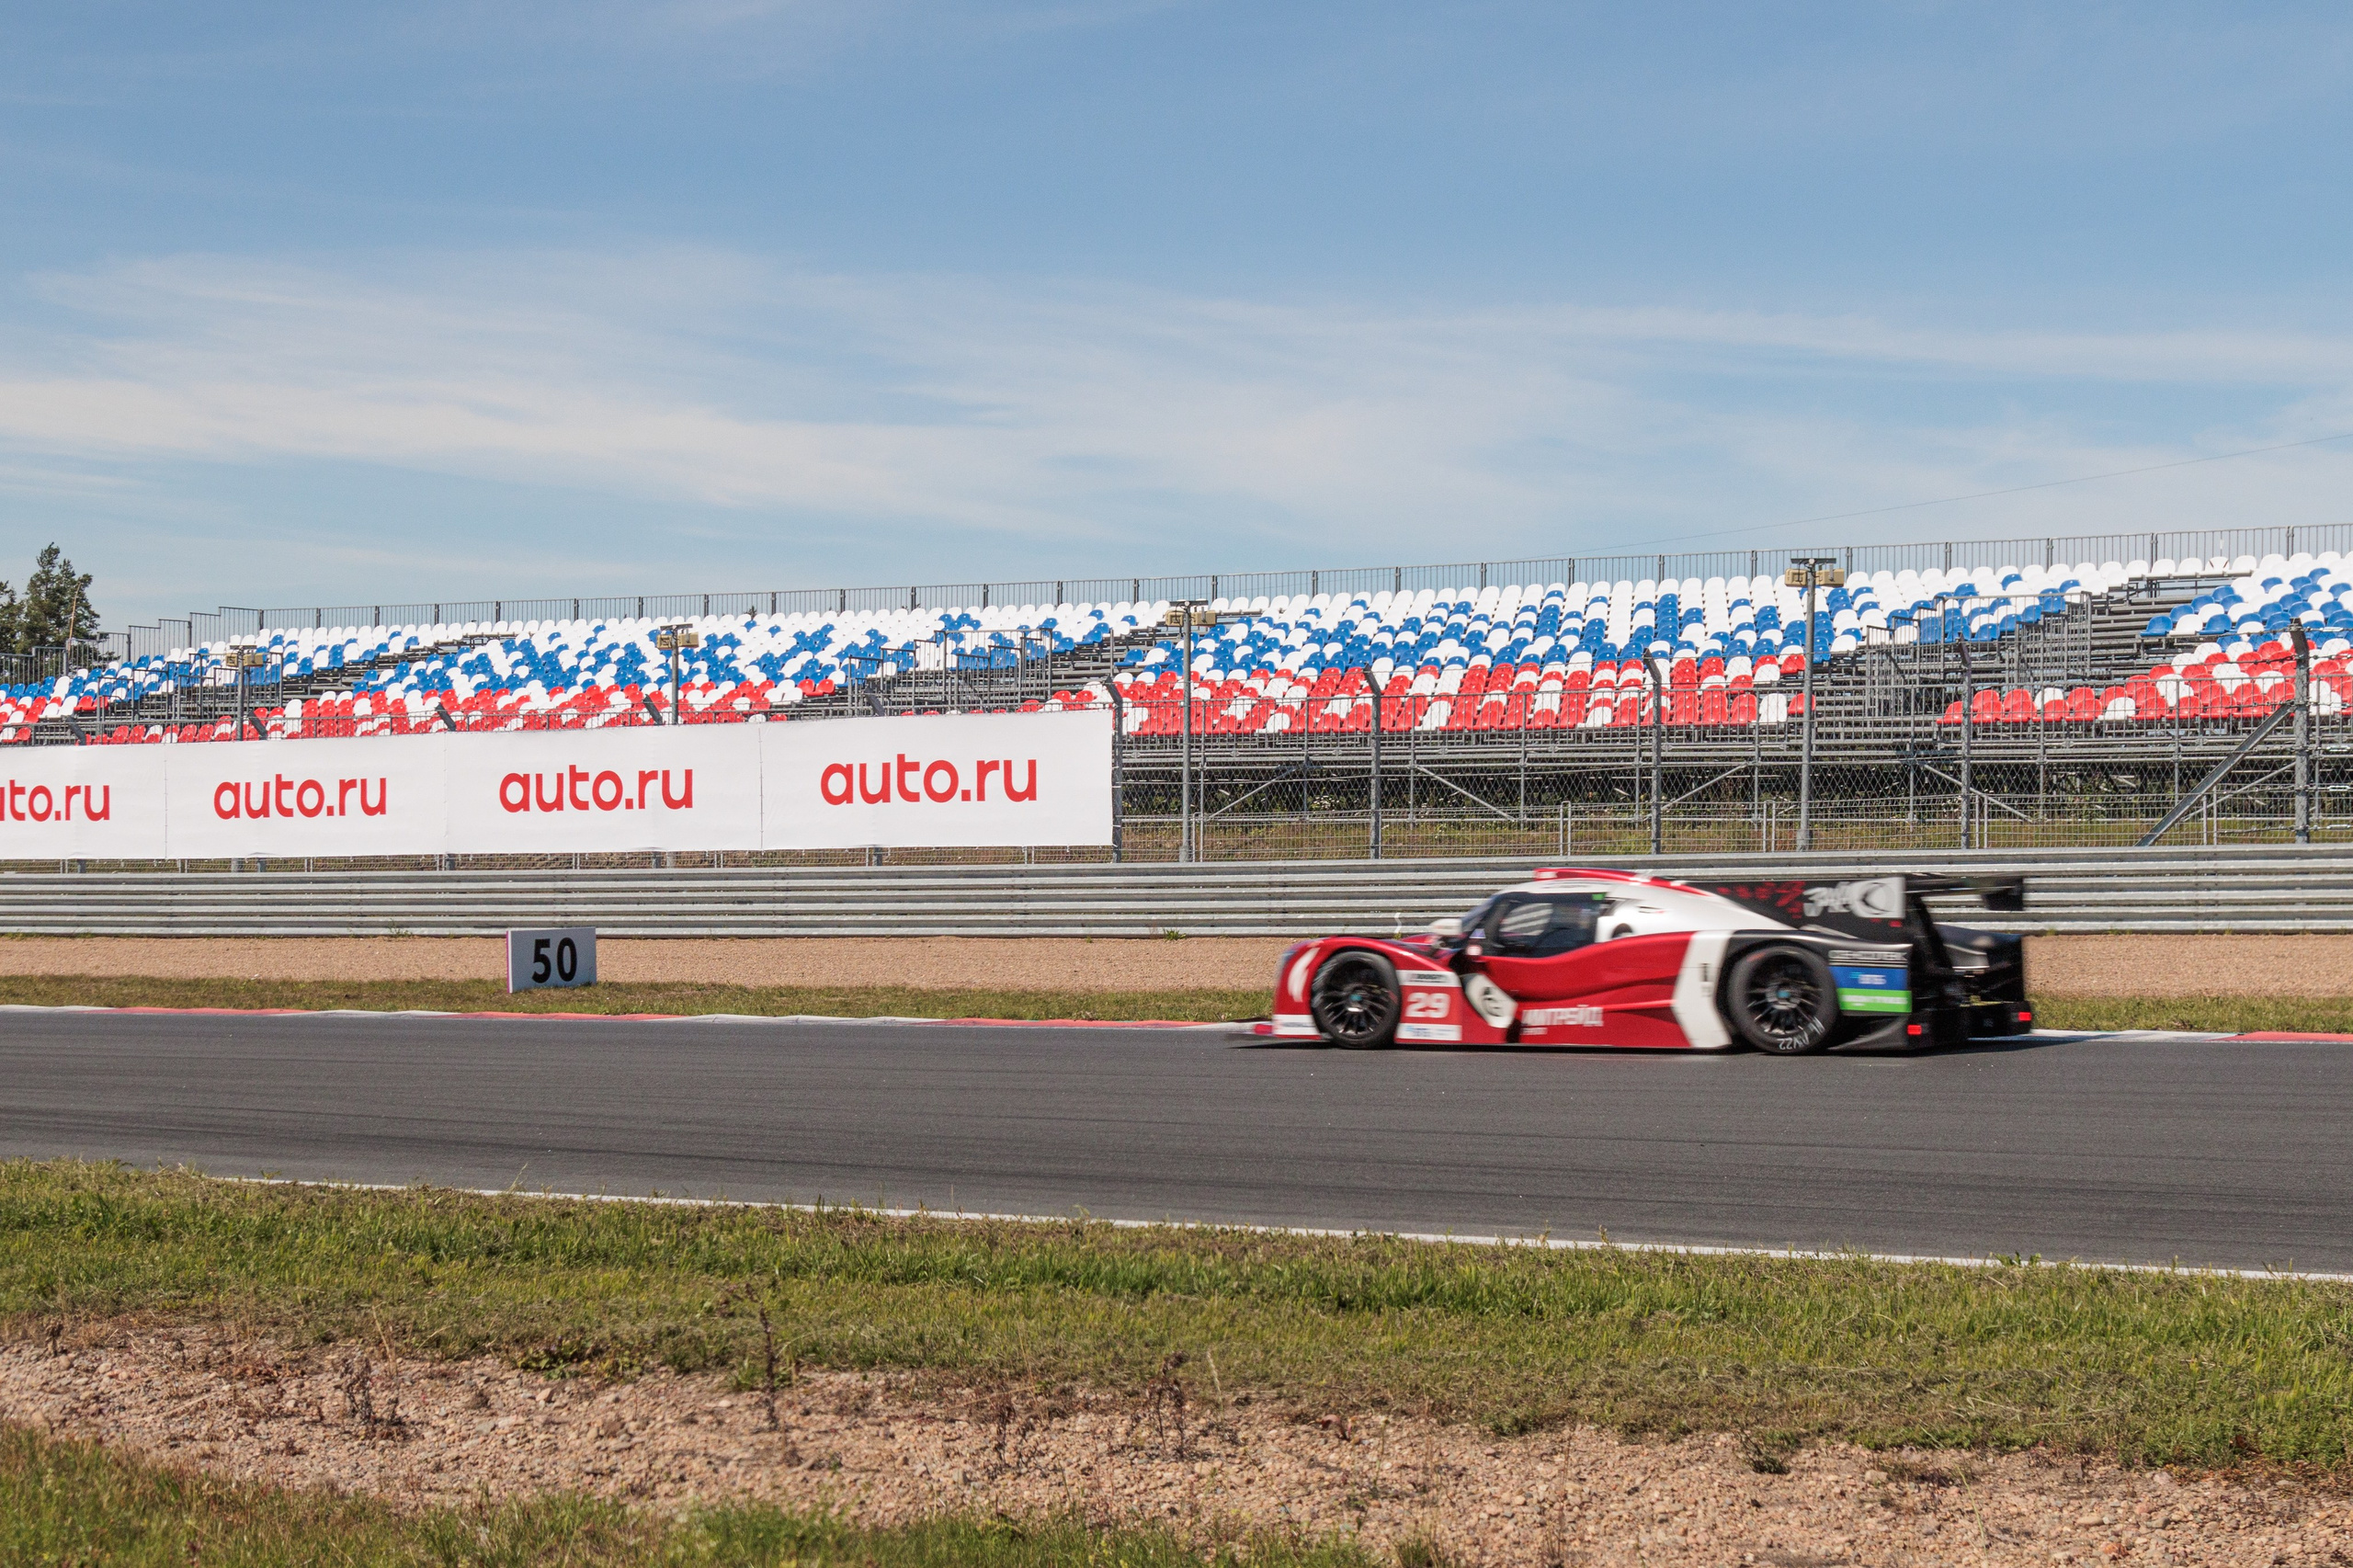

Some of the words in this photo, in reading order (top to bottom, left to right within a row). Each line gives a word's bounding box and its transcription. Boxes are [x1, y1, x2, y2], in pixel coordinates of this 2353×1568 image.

[0, 779, 110, 823] to.ru
[213, 773, 387, 820] auto.ru
[499, 764, 694, 812] auto.ru
[821, 754, 1038, 806] auto.ru
[531, 937, 577, 983] 50
[1404, 992, 1451, 1019] 29
